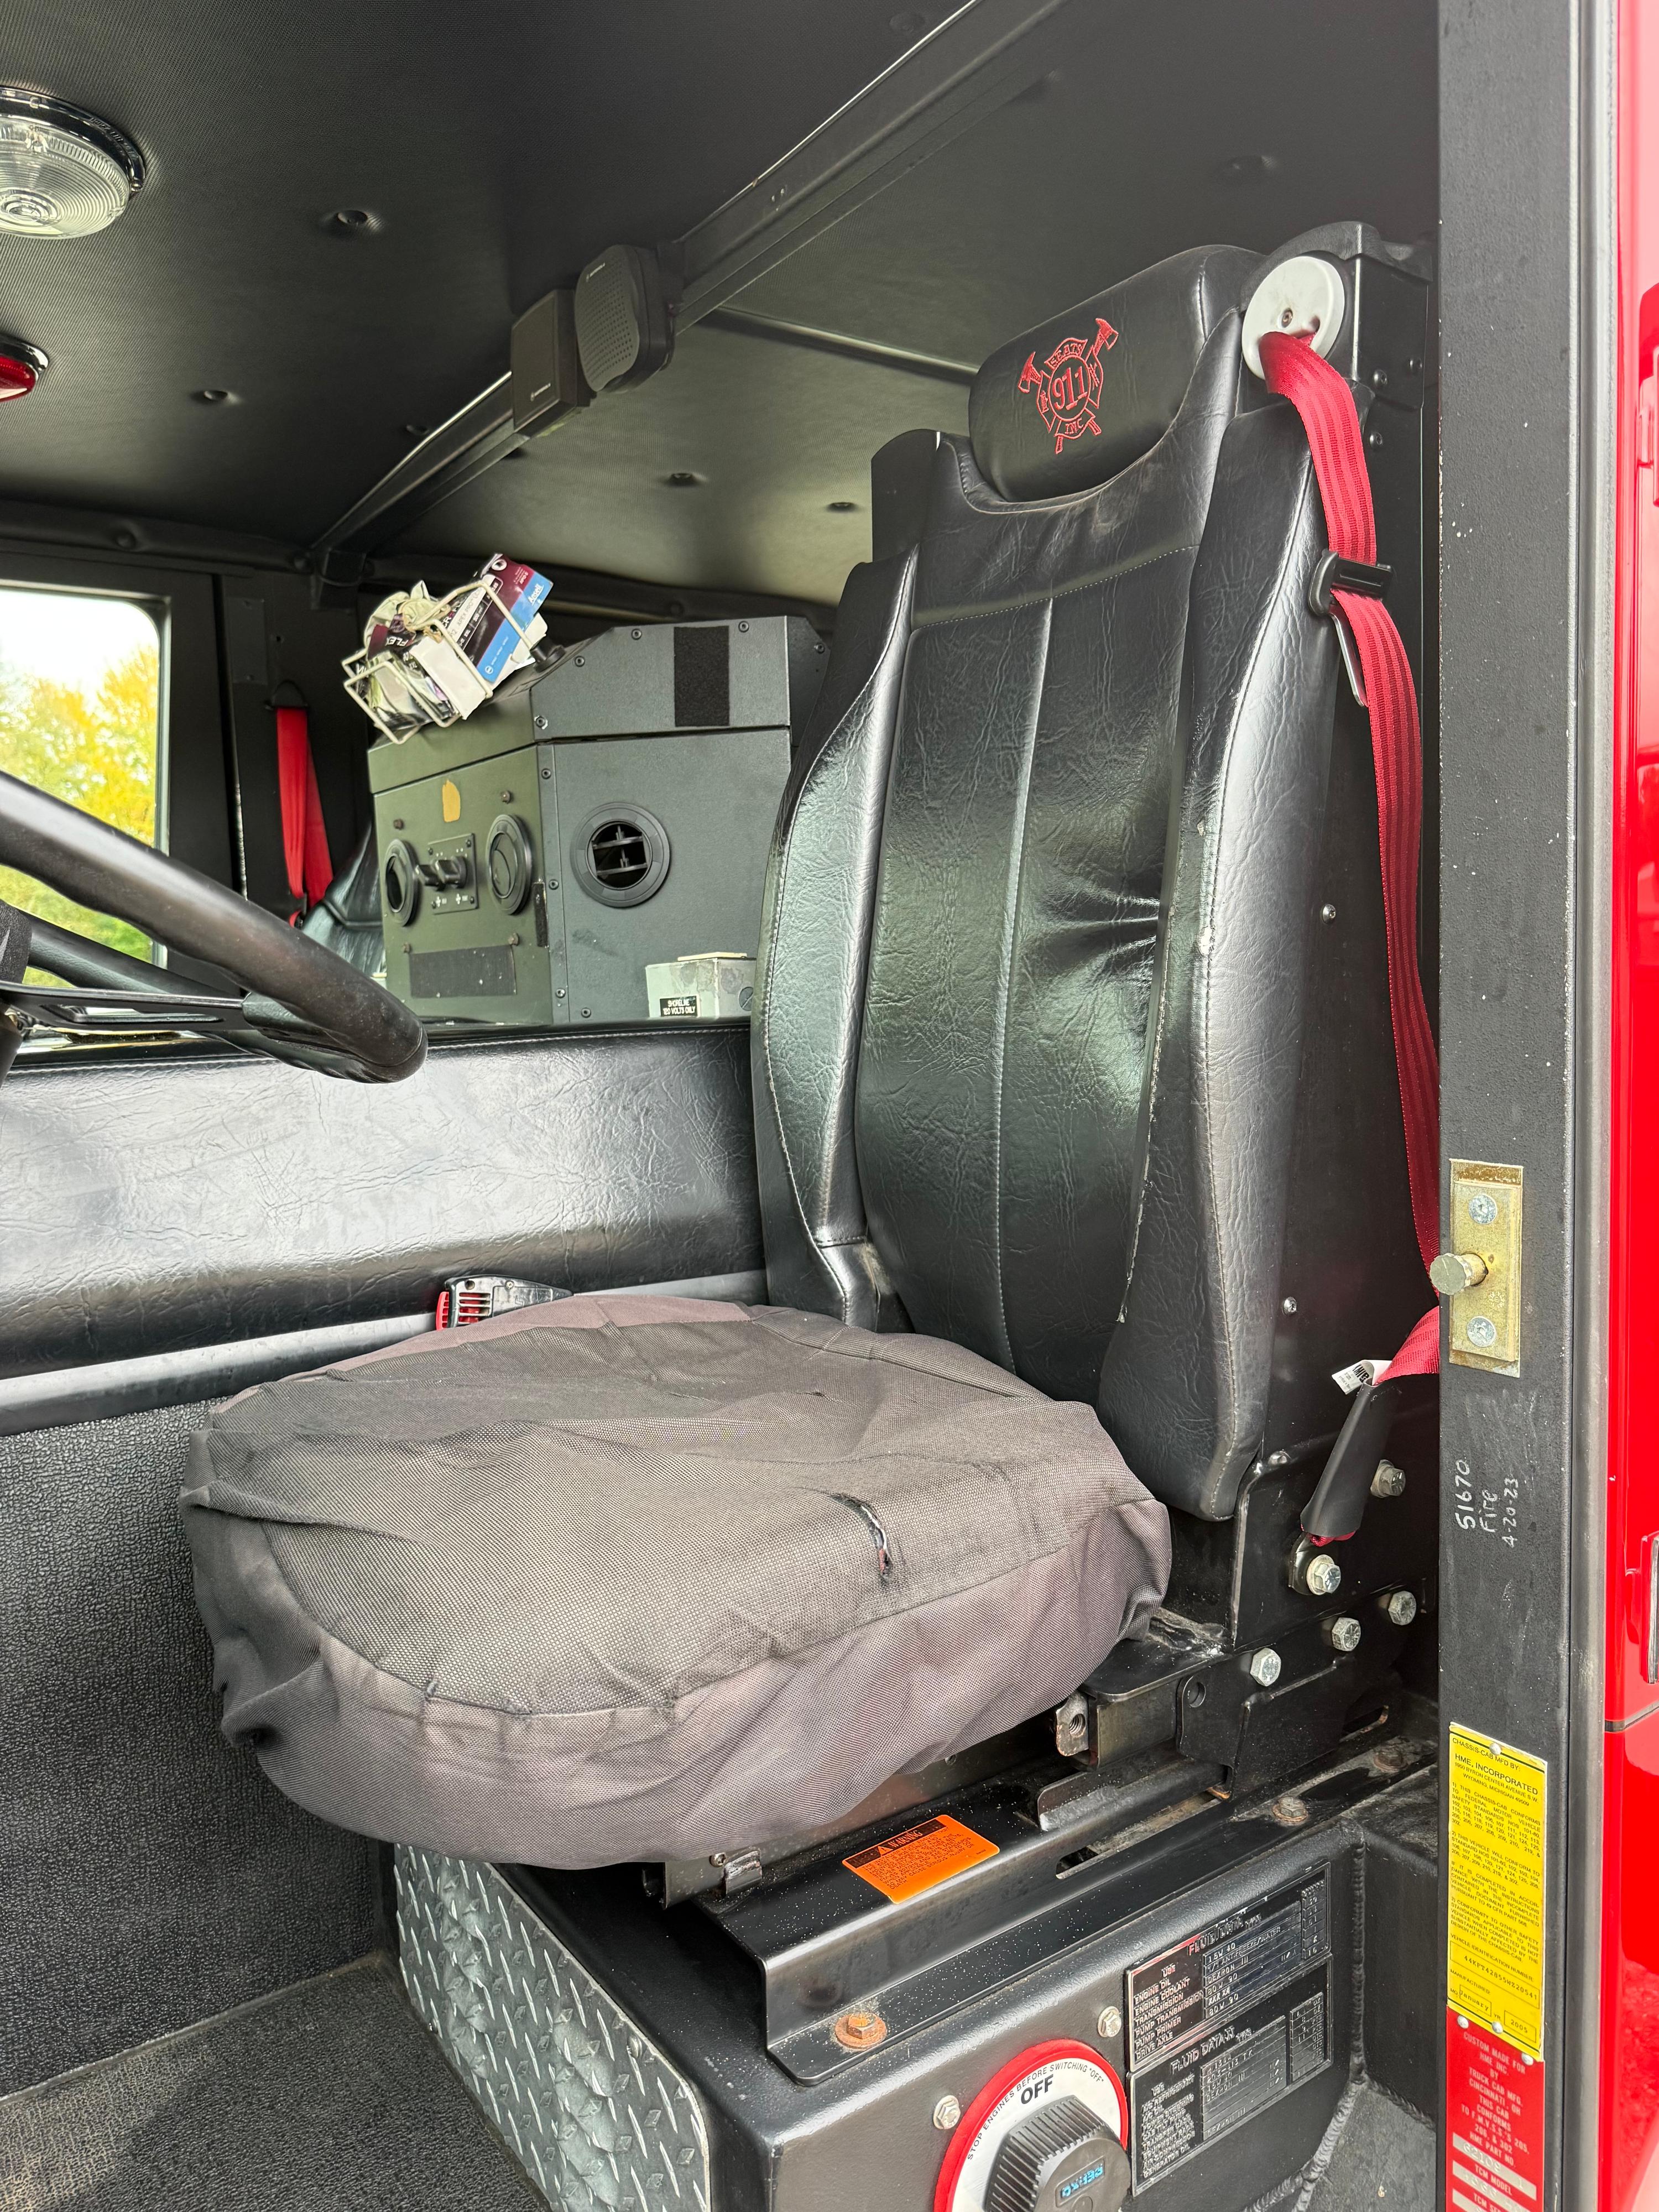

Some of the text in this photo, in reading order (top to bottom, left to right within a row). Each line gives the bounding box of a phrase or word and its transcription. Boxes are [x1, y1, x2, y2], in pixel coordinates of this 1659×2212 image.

[1051, 343, 1082, 367] SEATS
[1052, 366, 1088, 410] 911
[1065, 418, 1084, 434] INC
[528, 583, 543, 603] Ansell
[668, 999, 690, 1007] SHORELINE
[1502, 1478, 1519, 1548] 4-20-23
[1453, 1737, 1520, 1771] CHASSIS-CAB MFD BY:
[1455, 1753, 1537, 1796] HME, INCORPORATED
[1455, 1762, 1464, 1770] 1950
[1466, 1766, 1483, 1778] BYRON
[1484, 1775, 1504, 1788] CENTER
[1505, 1784, 1526, 1797] AVENUE
[1452, 1793, 1470, 1806] SAFETY
[1474, 1803, 1504, 1822] STANDARDS
[1460, 1785, 1470, 1794] THIS
[1474, 1791, 1506, 1811] CHASSIS-CAB
[1511, 1808, 1540, 1826] CONFORMS
[1489, 1785, 1514, 1800] MICHIGAN
[1515, 1796, 1528, 1807] 49509
[1465, 1793, 1486, 1808] FEDERAL
[1493, 1806, 1511, 1819] MOTOR
[1519, 1818, 1540, 1832] VEHICLE
[886, 1829, 924, 1848] WARNING
[1458, 1833, 1468, 1843] THIS
[1469, 1839, 1489, 1853] VEHICLE
[1491, 1849, 1503, 1859] WILL
[1505, 1856, 1531, 1873] CONFORM
[1188, 1930, 1215, 1957] FLUID
[1451, 1933, 1469, 1947] VEHICLE
[1472, 1944, 1509, 1969] IDENTIFICATION
[1163, 1962, 1175, 1978] USE
[1208, 1962, 1234, 1984] DEXRON
[1134, 1976, 1171, 2005] ENGINE OIL
[1134, 1976, 1190, 2016] ENGINE COOLANT
[1135, 1991, 1183, 2026] TRANSMISSION
[1135, 1990, 1204, 2038] PUMP TRANSMISSION
[1459, 1989, 1488, 2012] January
[1510, 2018, 1527, 2033] 2005
[1135, 2015, 1181, 2049] PUMP PRIMER
[1135, 2031, 1172, 2060] DRIVE AXLE
[1171, 2047, 1199, 2075] FLUID
[1464, 2031, 1525, 2074] CUSTOM MADE FOR
[1480, 2051, 1493, 2066] HME
[1020, 2074, 1053, 2104] OFF
[1152, 2081, 1164, 2097] USE
[1469, 2066, 1489, 2086] TRUCK
[1491, 2080, 1504, 2096] CAB
[1490, 2068, 1498, 2081] BY
[1207, 2079, 1232, 2103] DEXRON
[968, 2132, 983, 2160] STOP
[983, 2090, 1015, 2131] ENGINES
[1016, 2067, 1047, 2092] BEFORE
[1050, 2062, 1088, 2073] SWITCHING
[1462, 2104, 1469, 2117] TO
[1477, 2103, 1511, 2132] CONFORMS
[1479, 2094, 1509, 2120] THIS CAB
[1511, 2103, 1520, 2116] OH
[1470, 2131, 1483, 2147] HME
[1485, 2141, 1501, 2159] PART
[1500, 2138, 1512, 2155] 302
[1474, 2163, 1488, 2180] TCM
[1491, 2174, 1512, 2197] MODEL
[1474, 2192, 1488, 2210] TCM
